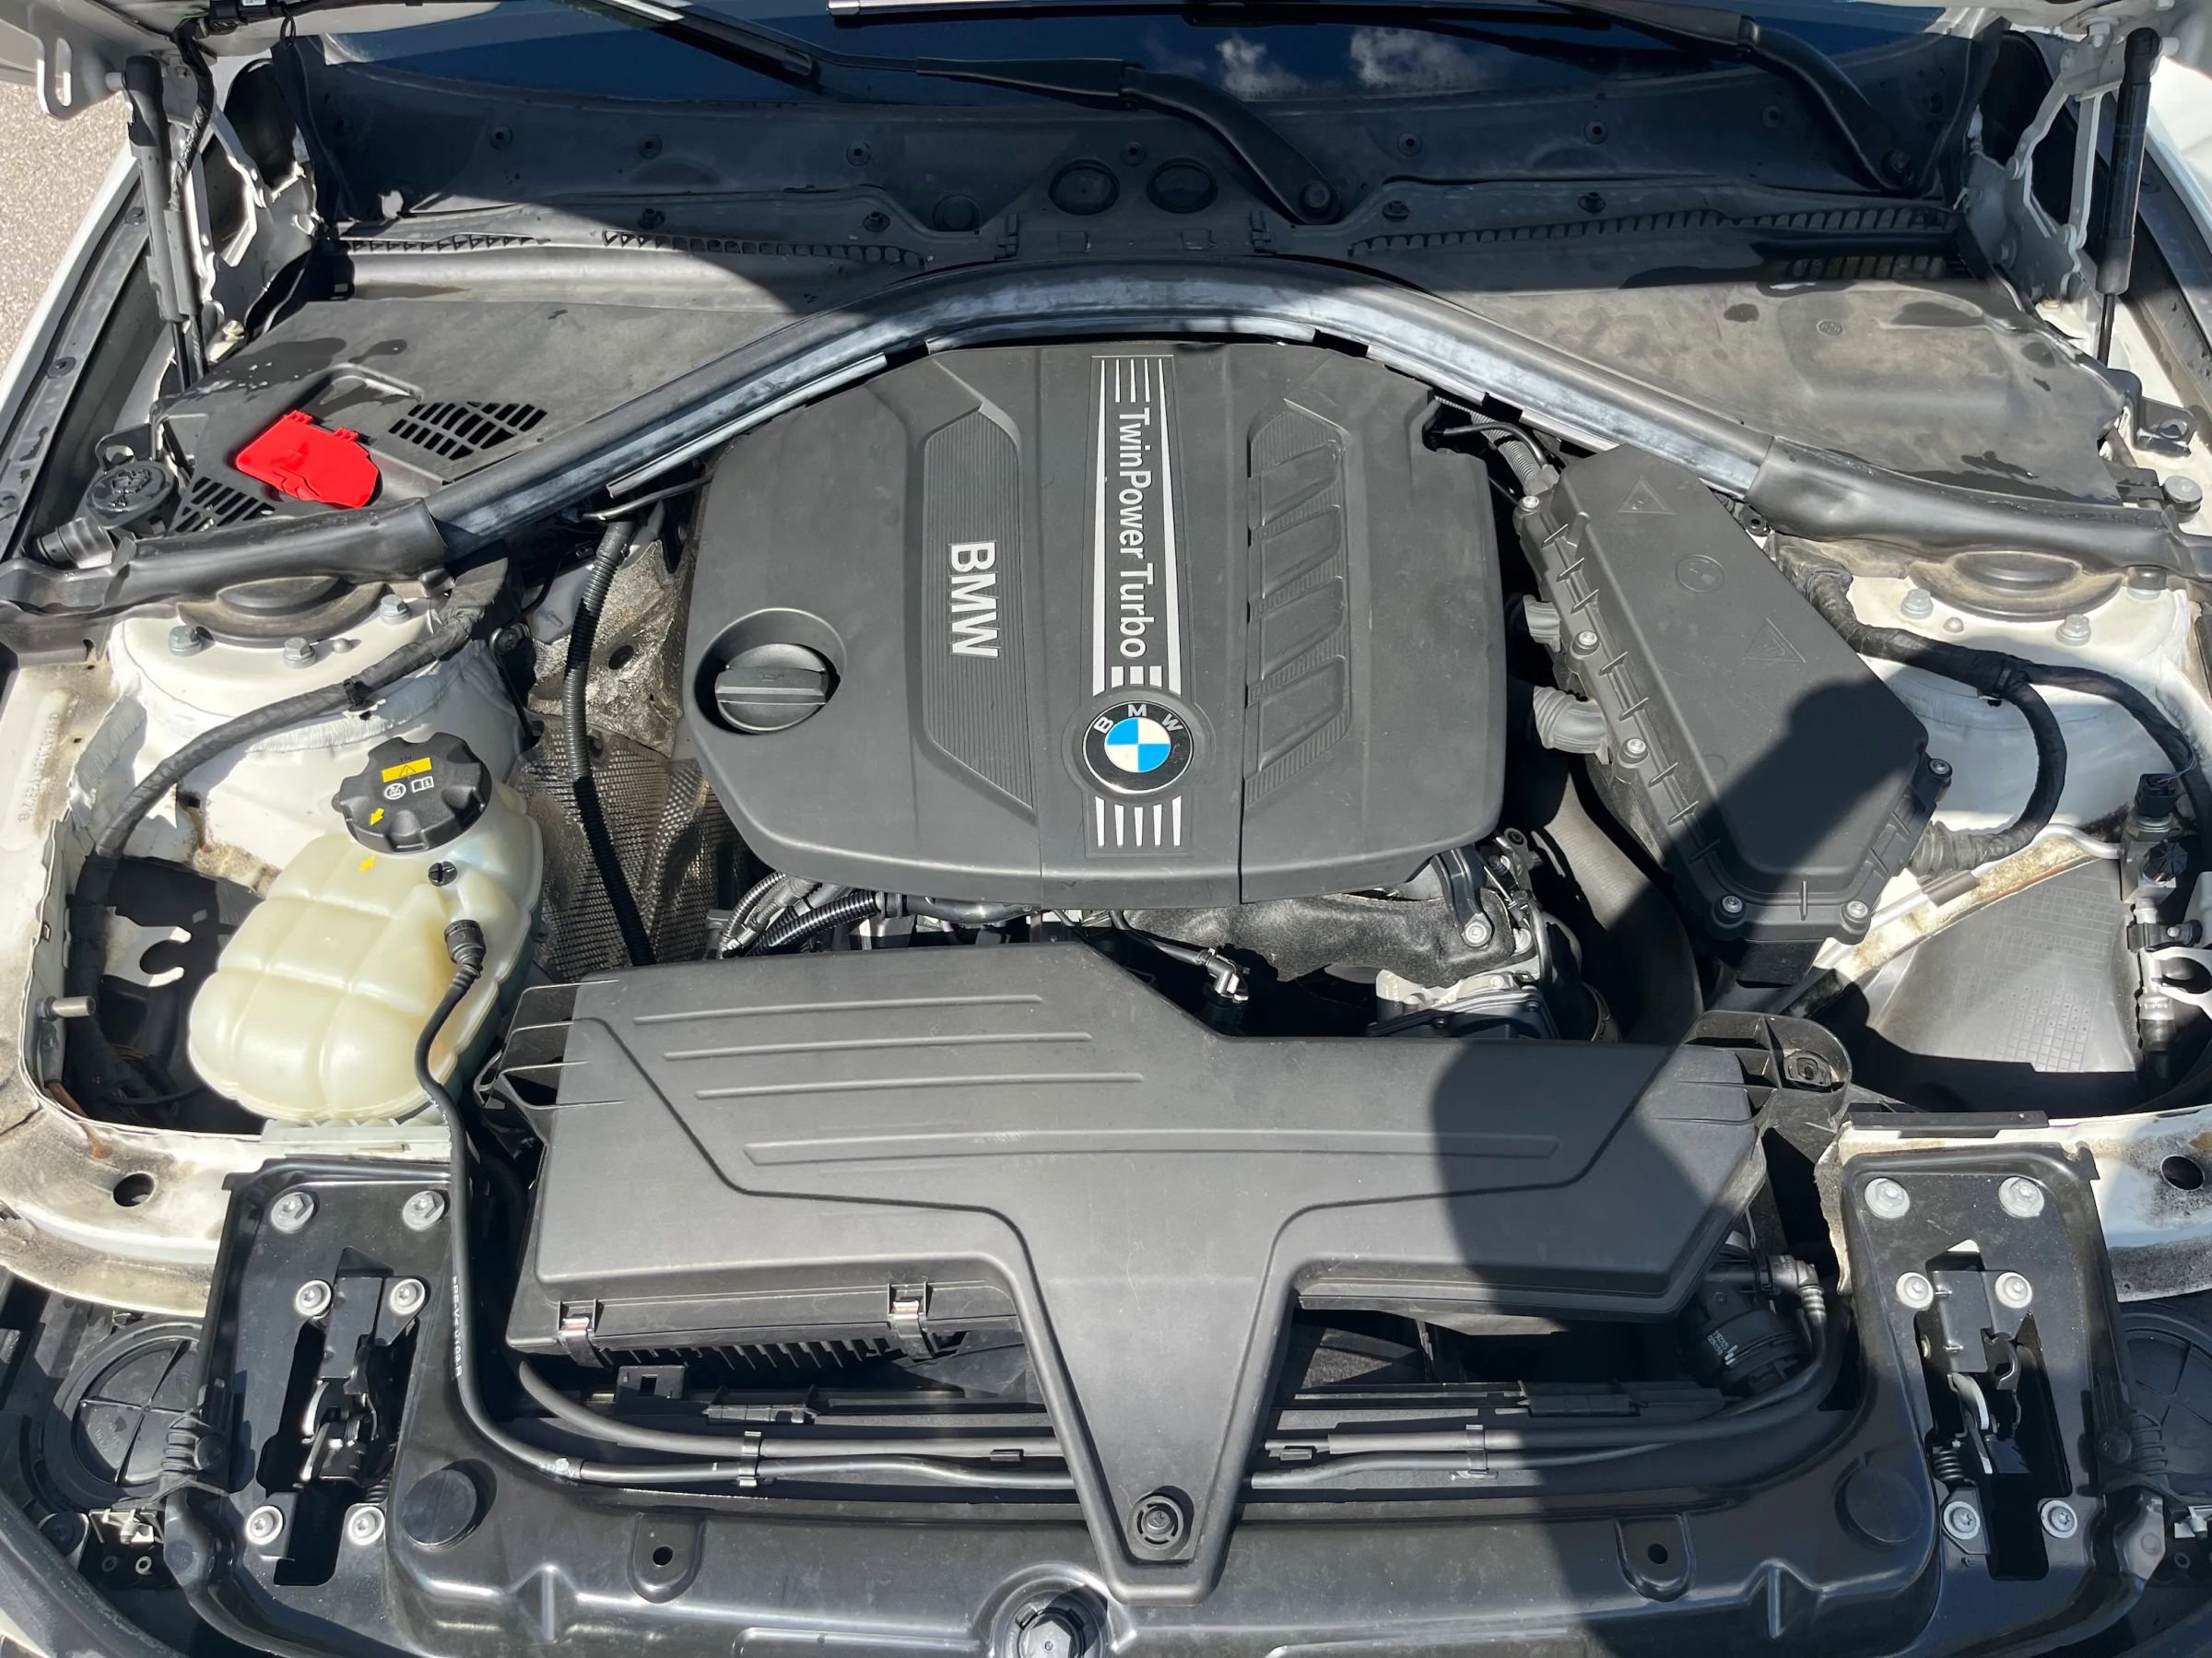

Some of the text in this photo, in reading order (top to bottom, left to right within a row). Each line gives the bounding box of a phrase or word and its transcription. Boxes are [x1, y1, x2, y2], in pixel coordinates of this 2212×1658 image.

[1119, 407, 1155, 658] TwinPower Turbo
[951, 542, 999, 657] BMW
[1093, 703, 1184, 735] BMW
